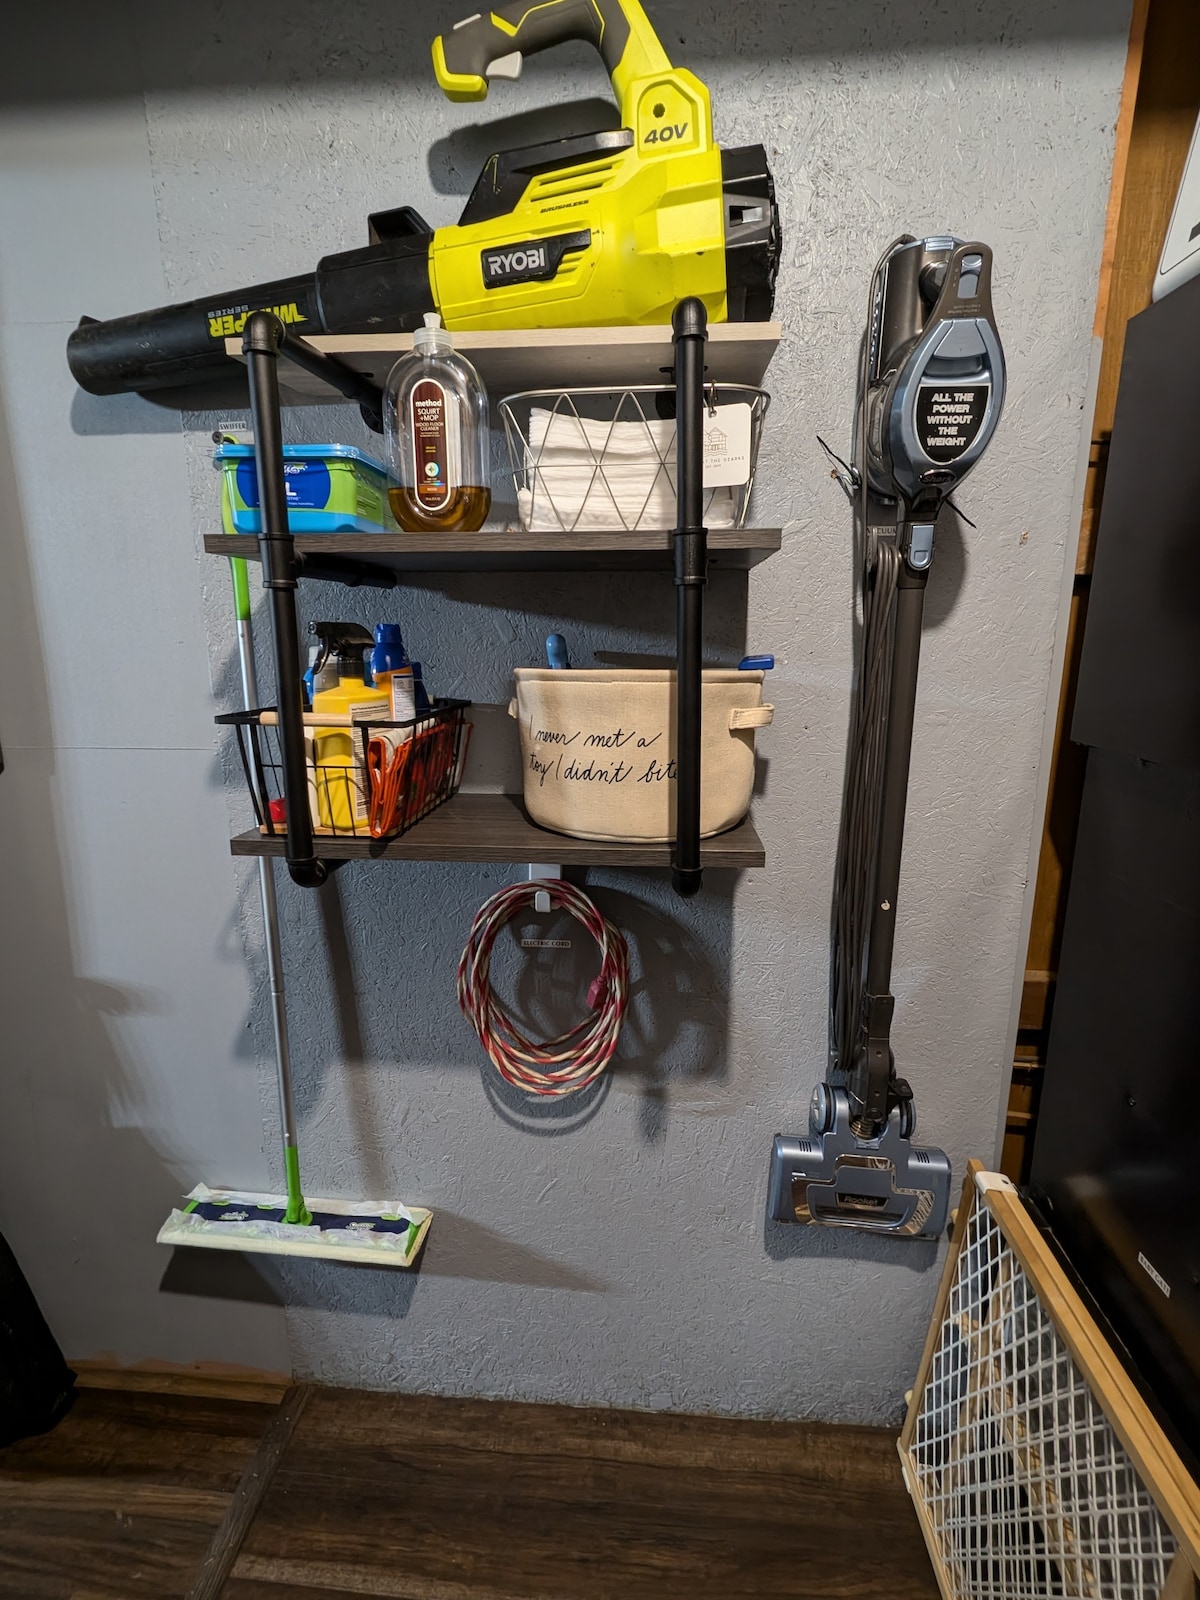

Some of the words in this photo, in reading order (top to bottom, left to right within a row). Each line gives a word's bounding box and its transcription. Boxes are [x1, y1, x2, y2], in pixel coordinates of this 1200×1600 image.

[644, 122, 689, 144] 40V
[488, 247, 546, 276] RYOBI
[207, 304, 249, 319] SERIES
[208, 303, 309, 338] WPER
[931, 393, 952, 402] ALL
[954, 392, 975, 402] THE
[415, 399, 442, 407] method
[932, 404, 971, 413] POWER
[926, 415, 973, 425] WITHOUT
[938, 426, 959, 435] THE
[927, 437, 967, 447] WEIGHT
[535, 730, 581, 746] never
[584, 728, 636, 748] met
[637, 732, 663, 748] a
[529, 753, 555, 787] toy
[563, 758, 633, 785] didn't
[844, 1195, 880, 1206] Rocket
